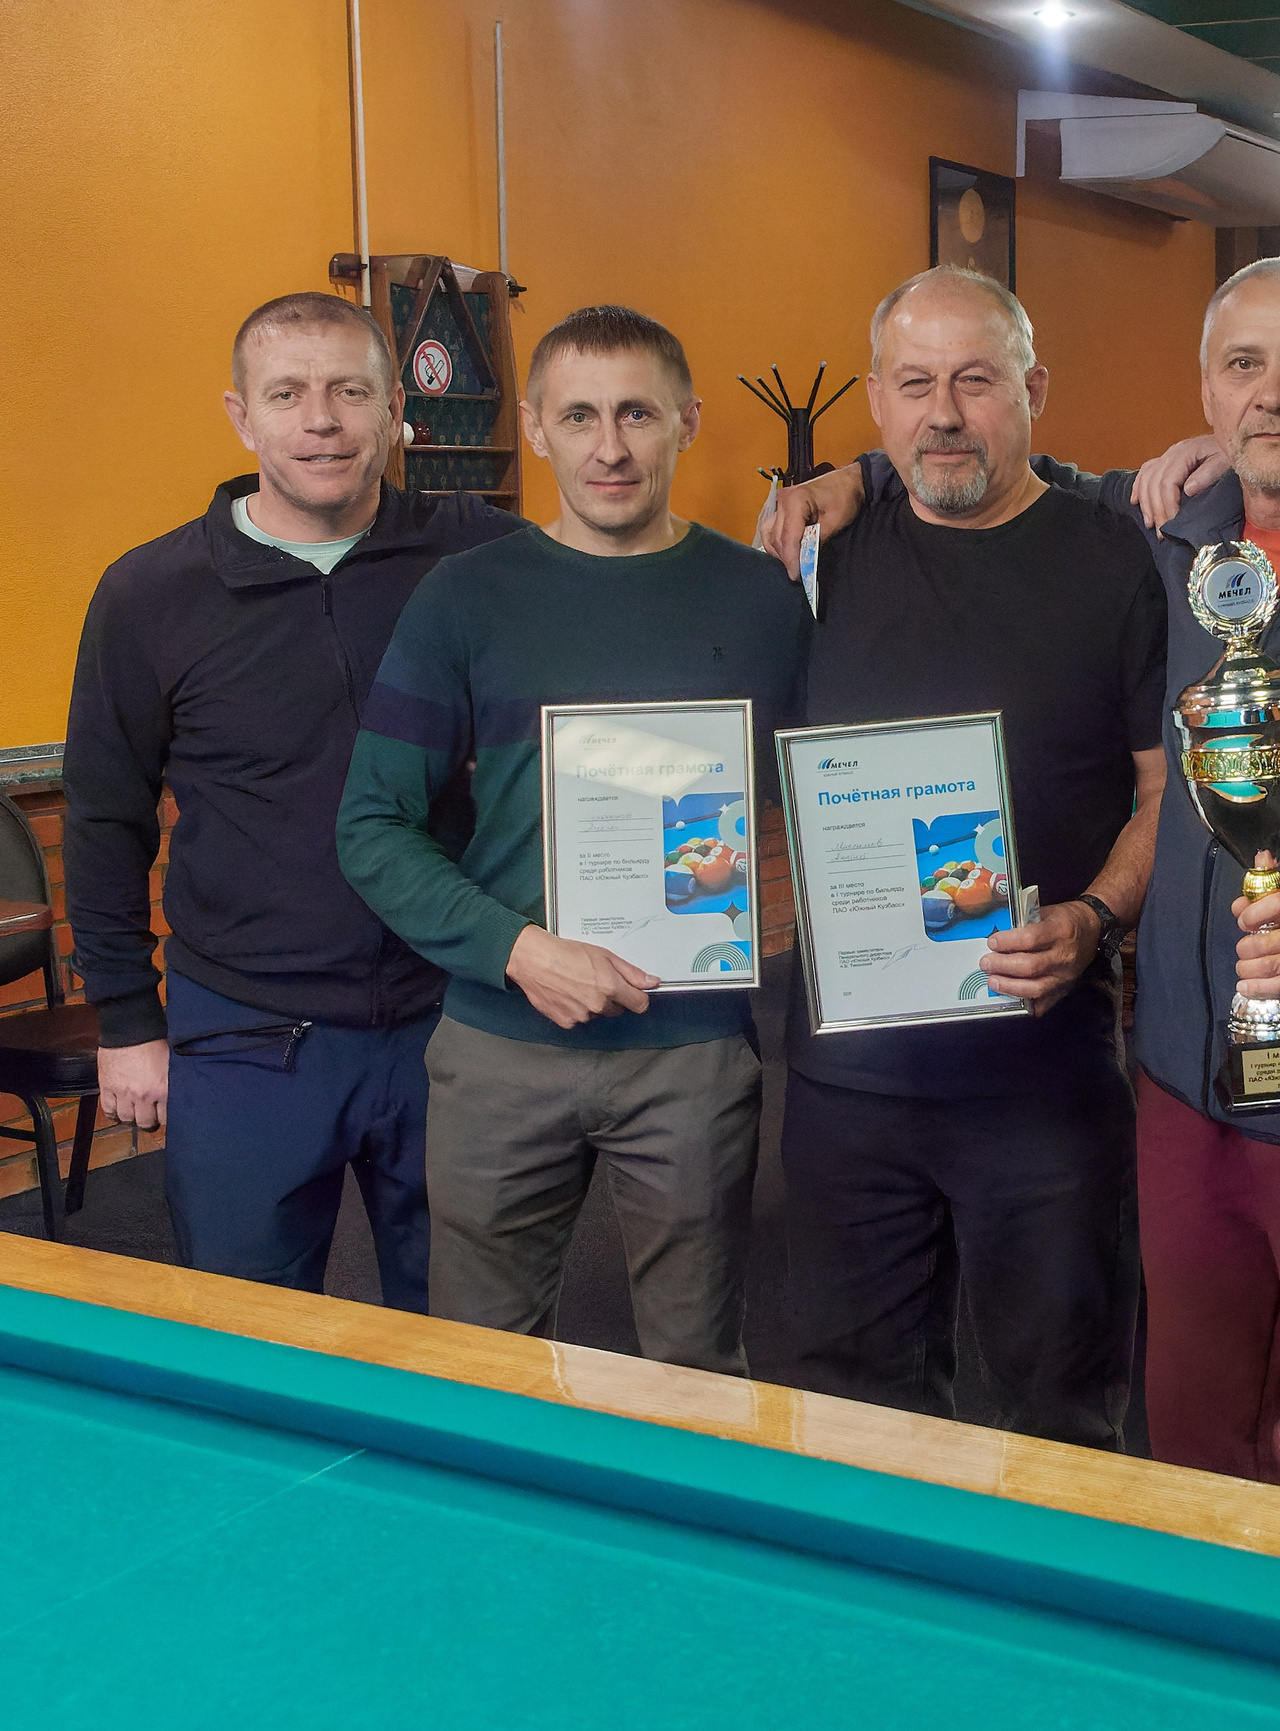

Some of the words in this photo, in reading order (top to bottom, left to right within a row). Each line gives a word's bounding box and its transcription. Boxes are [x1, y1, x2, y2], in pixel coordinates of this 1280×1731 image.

[1218, 587, 1251, 599] МЕЧЕЛ
[831, 760, 858, 769] МЕЧЕЛ
[576, 763, 654, 778] Почётная
[659, 762, 724, 775] грамота
[818, 788, 900, 806] Почётная
[906, 780, 976, 799] грамота
[822, 822, 865, 831] награждается
[851, 896, 888, 905] работников
